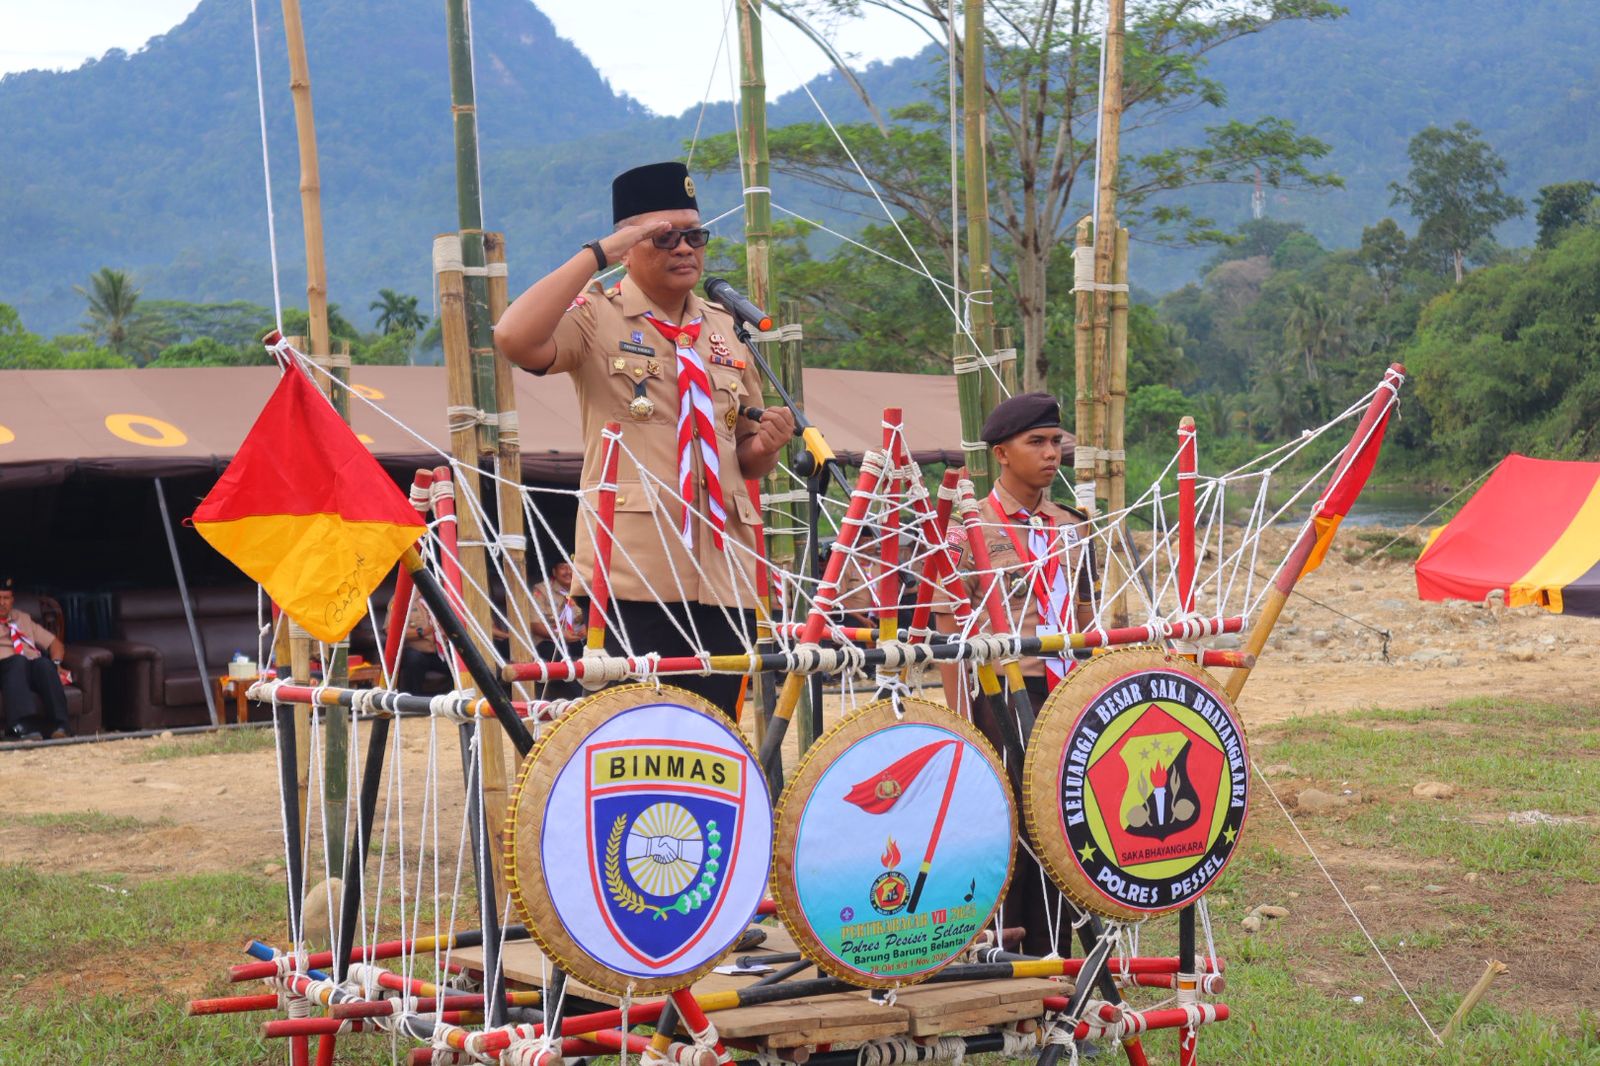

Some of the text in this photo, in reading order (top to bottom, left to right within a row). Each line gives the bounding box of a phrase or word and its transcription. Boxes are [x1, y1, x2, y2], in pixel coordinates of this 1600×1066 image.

[1066, 679, 1245, 827] KELUARGA BESAR SAKA BHAYANGKARA
[610, 755, 726, 785] BINMAS
[1121, 841, 1203, 862] SAKA BHAYANGKARA
[1096, 854, 1224, 904] POLRES PESSEL
[931, 909, 947, 924] VII
[840, 923, 976, 956] Polres Pesisir Selatan
[854, 937, 966, 965] Barung Barung Belantai
